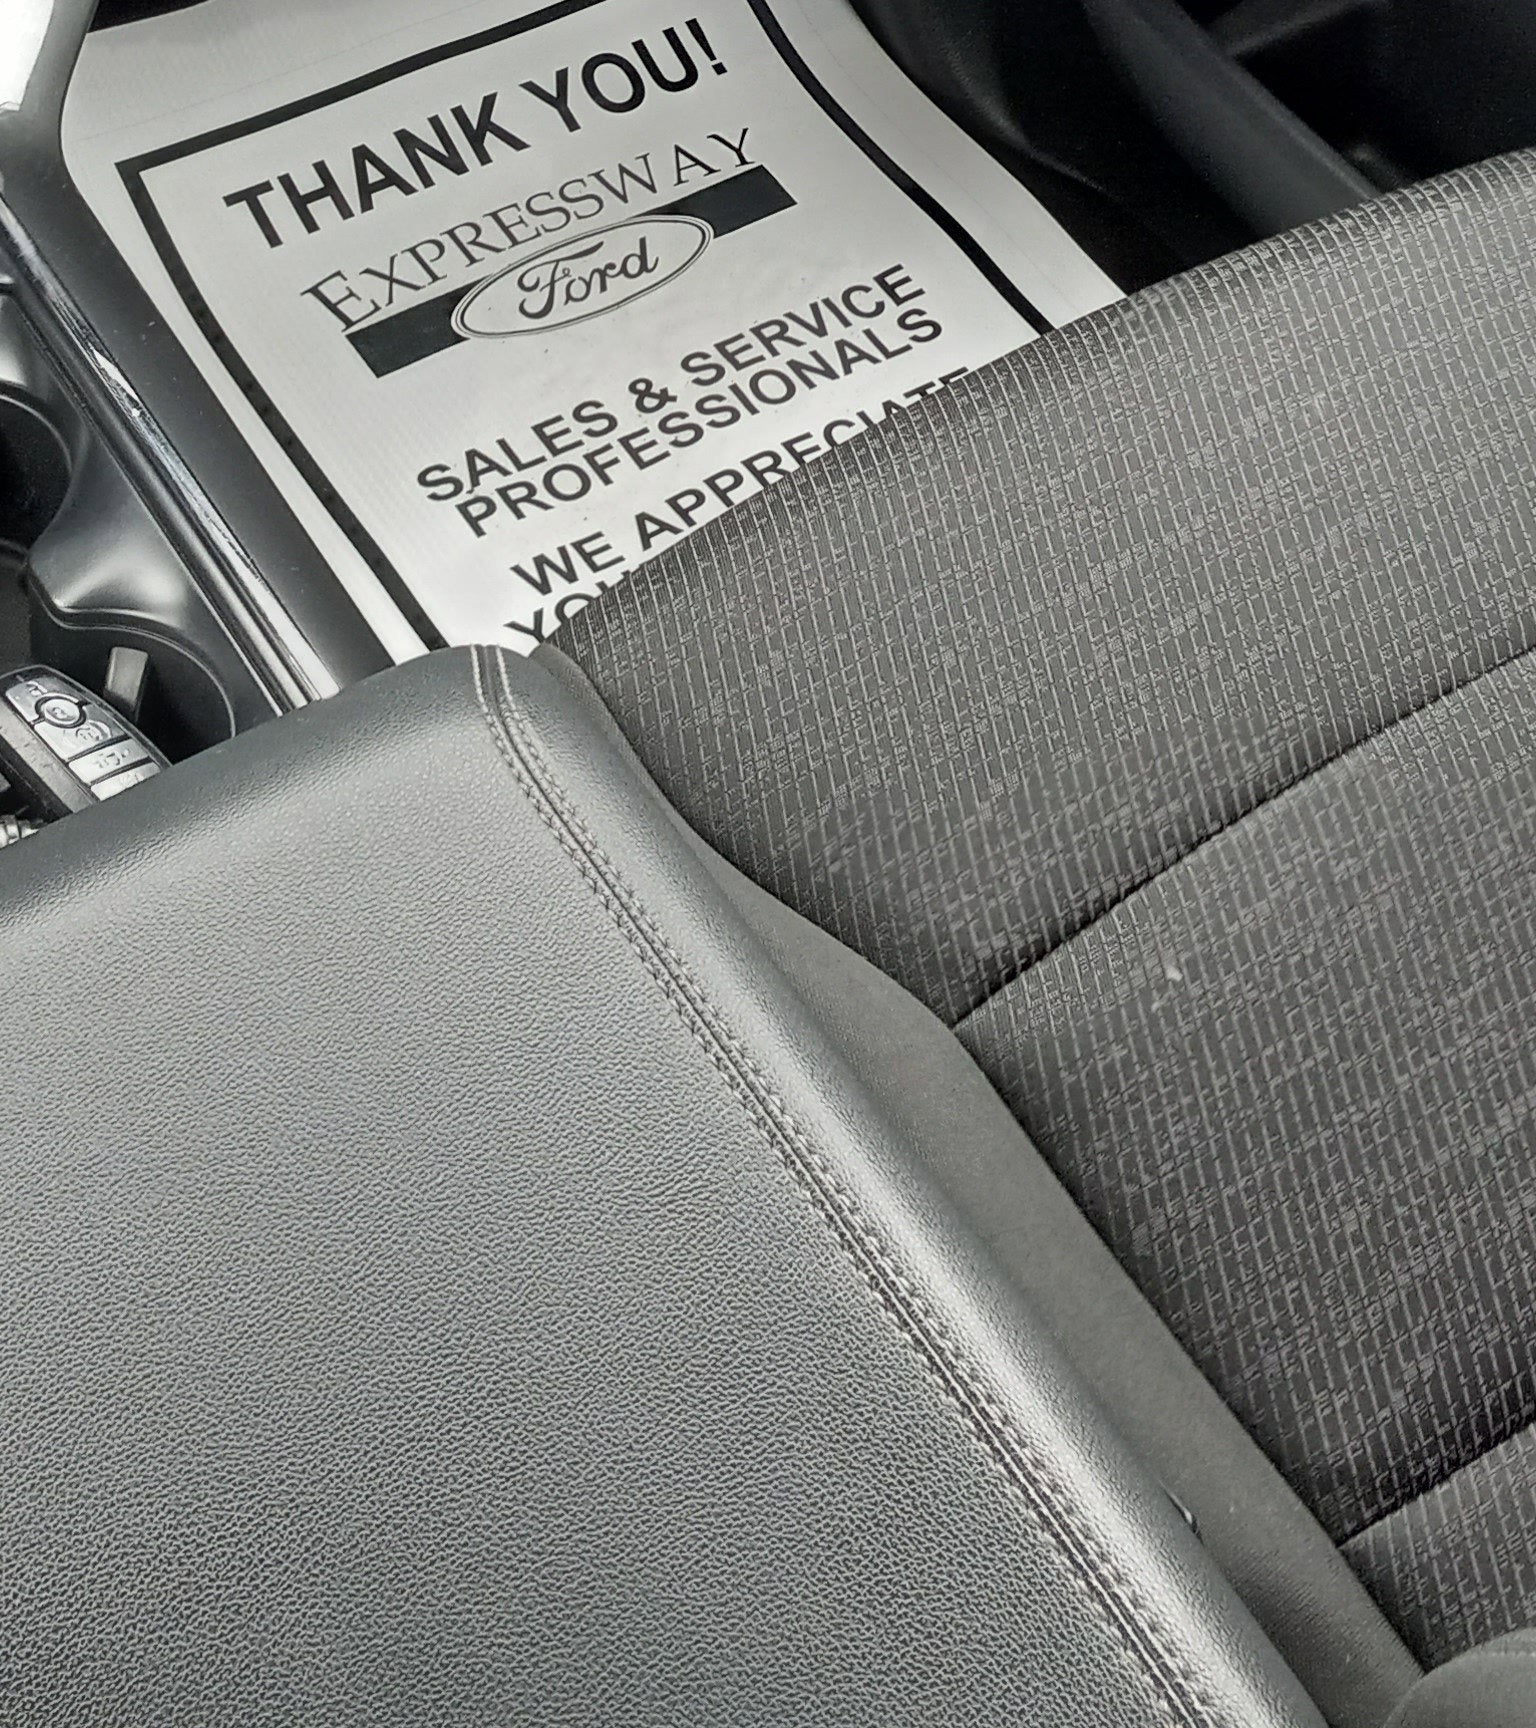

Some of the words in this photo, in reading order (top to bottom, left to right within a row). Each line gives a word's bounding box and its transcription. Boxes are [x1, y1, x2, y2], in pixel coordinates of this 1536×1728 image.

[222, 91, 531, 249] THANK
[518, 17, 729, 134] YOU!
[299, 127, 760, 333] EXPRESSWAY
[416, 399, 619, 503] SALES
[627, 377, 678, 415] &
[679, 263, 927, 389] SERVICE
[516, 235, 660, 322] Ford
[454, 307, 943, 539] PROFESSIONALS
[509, 530, 627, 597] WE
[635, 367, 970, 552] APPREC
